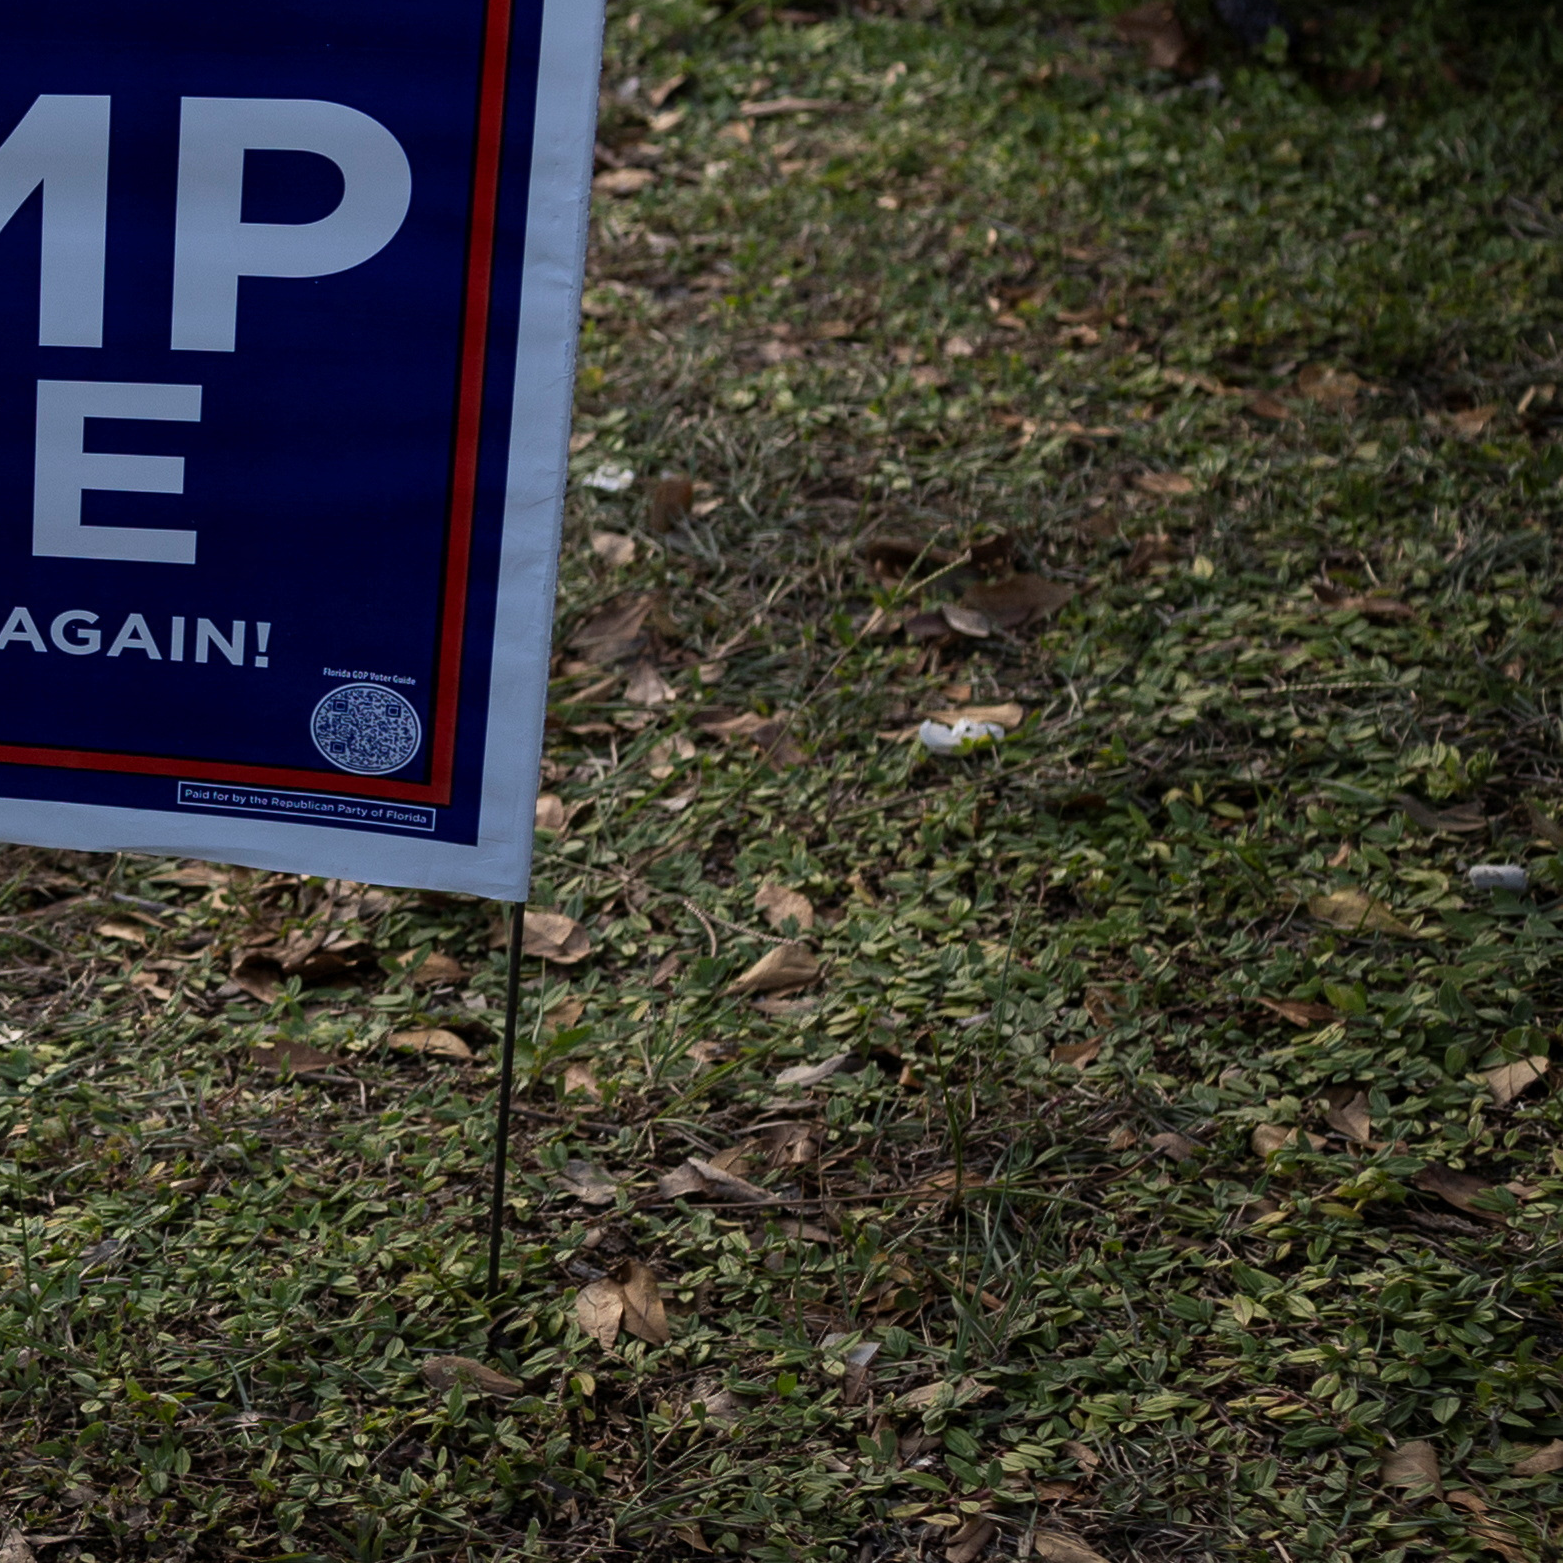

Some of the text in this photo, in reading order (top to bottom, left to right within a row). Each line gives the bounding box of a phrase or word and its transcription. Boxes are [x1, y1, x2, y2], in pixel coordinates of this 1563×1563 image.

[322, 667, 417, 686] Florida GOP Voter Guide
[184, 788, 428, 824] Paid for by the Republican Party of Florida
